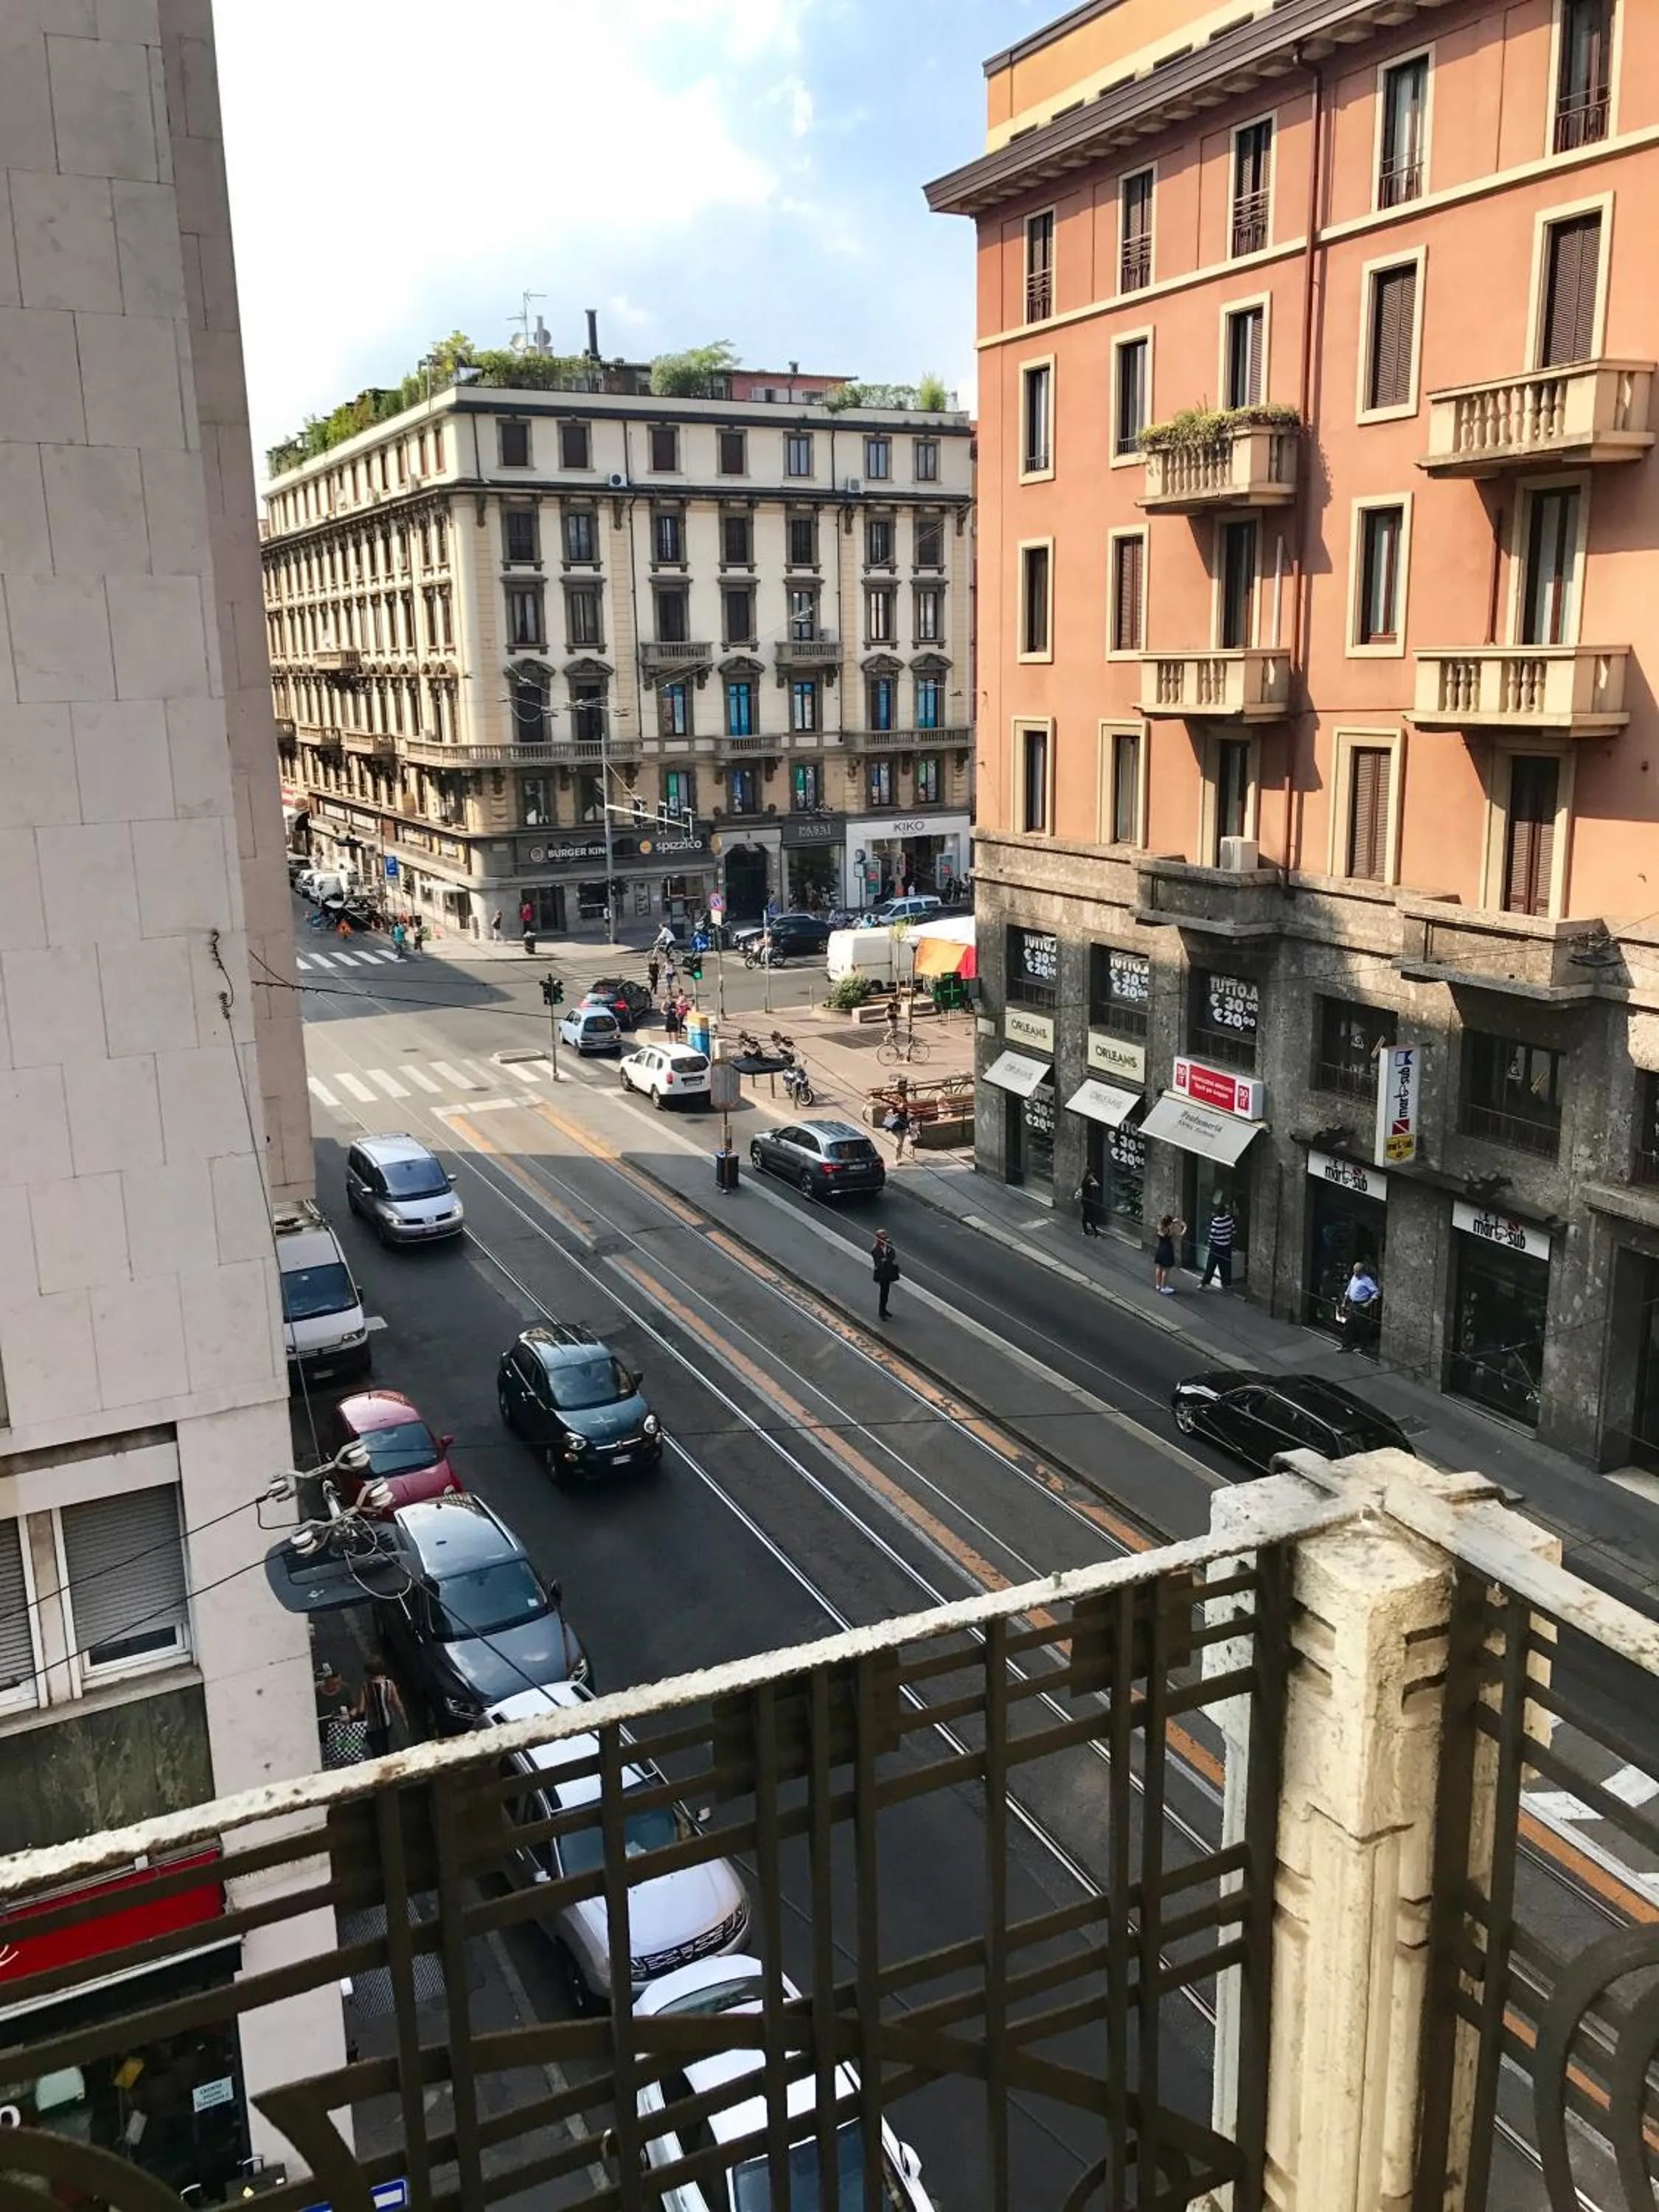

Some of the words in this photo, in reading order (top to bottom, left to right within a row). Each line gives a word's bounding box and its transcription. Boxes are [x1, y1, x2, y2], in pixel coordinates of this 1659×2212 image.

[894, 821, 925, 832] KIKO
[548, 847, 588, 858] BURGER
[588, 846, 606, 856] KIN
[655, 838, 702, 855] spizzico
[1210, 993, 1219, 1007] €
[1011, 1018, 1048, 1039] ORLEANS
[1096, 1045, 1138, 1068] ORLEANS
